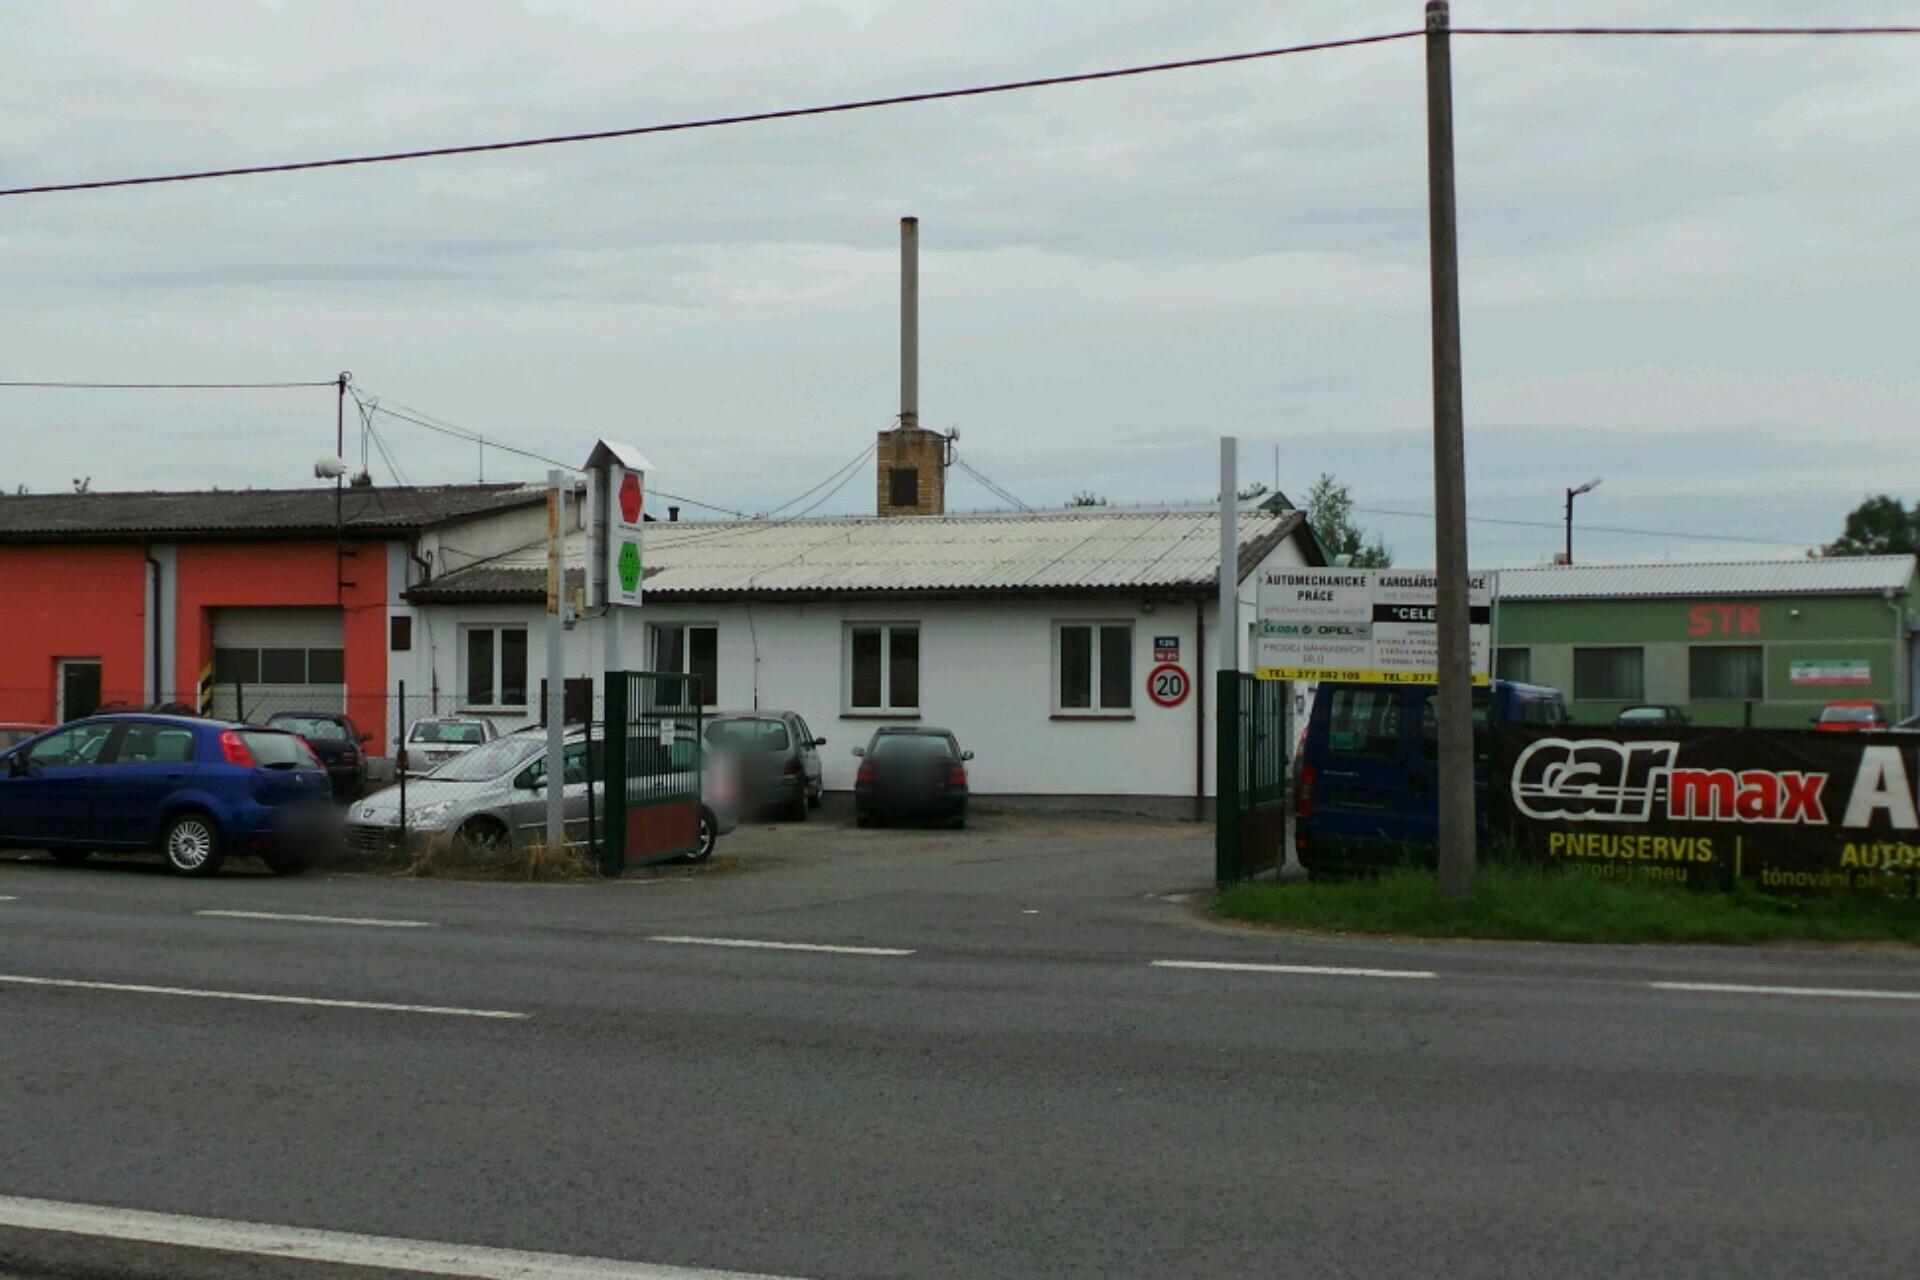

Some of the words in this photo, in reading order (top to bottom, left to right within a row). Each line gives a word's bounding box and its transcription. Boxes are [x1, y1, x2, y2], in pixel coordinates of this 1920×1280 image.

[1265, 573, 1367, 587] AUTOMECHANICKÉ
[1378, 574, 1437, 588] KAROSÁŘS
[1296, 589, 1335, 601] PRÁCE
[1687, 603, 1762, 637] STK
[1317, 625, 1354, 635] OPEL
[1296, 671, 1315, 679] 377
[1342, 672, 1360, 680] 105
[1157, 675, 1182, 696] 20
[1549, 831, 1713, 863] PNEUSERVIS
